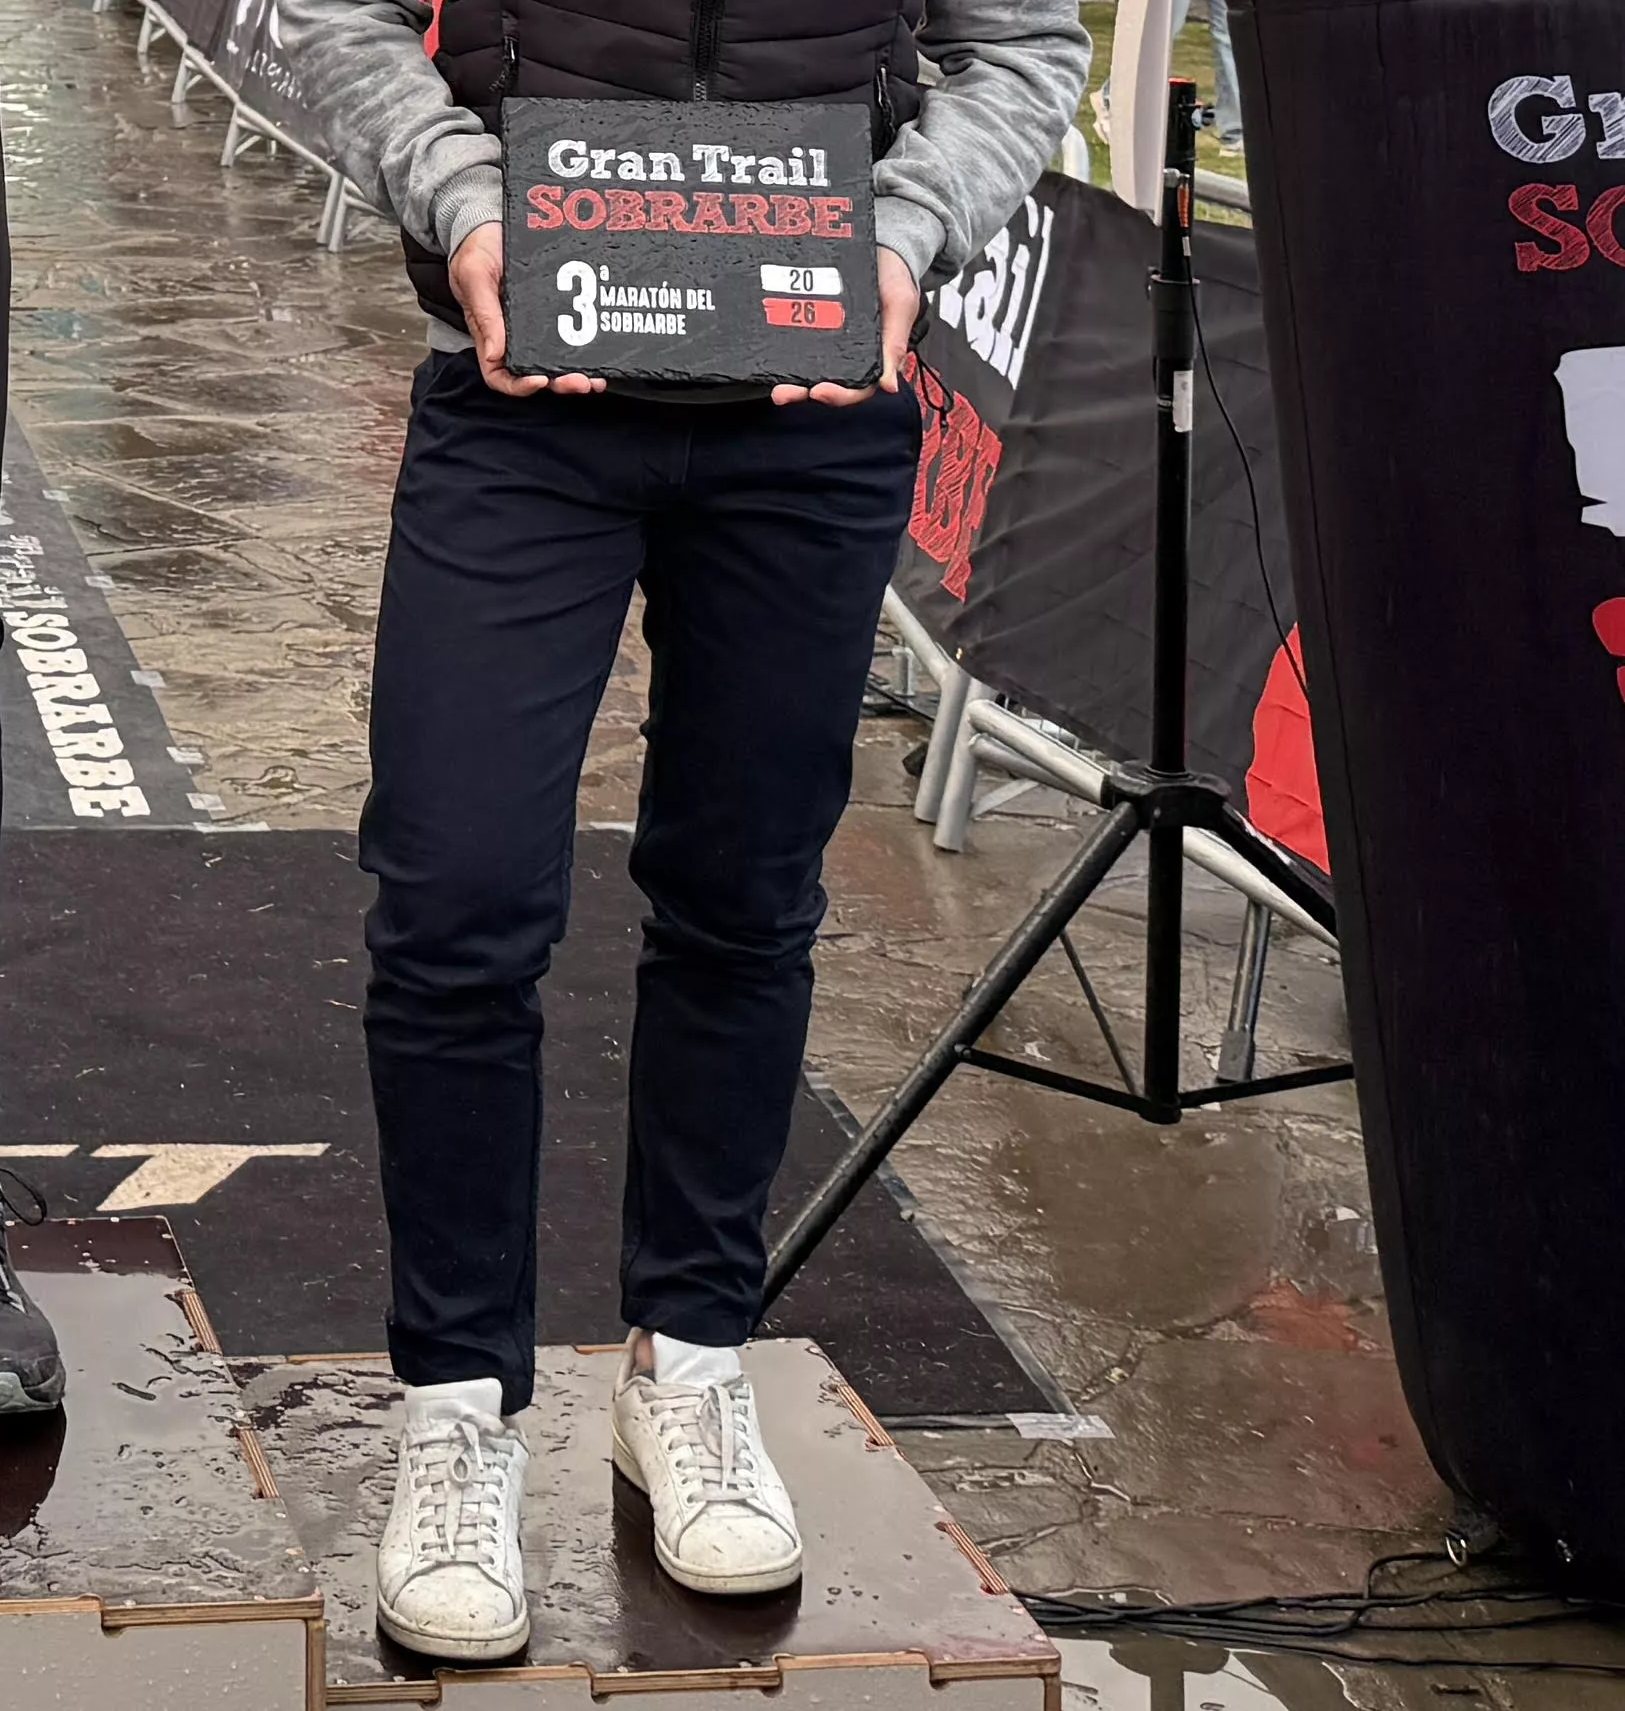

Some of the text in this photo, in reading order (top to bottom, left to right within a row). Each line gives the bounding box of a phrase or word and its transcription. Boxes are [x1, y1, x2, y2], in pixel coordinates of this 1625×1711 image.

[547, 138, 829, 188] Gran Trail
[525, 183, 854, 239] SOBRARBE
[599, 279, 716, 312] MARATÓN DEL
[788, 270, 815, 292] 20
[599, 311, 687, 336] SOBRARBE
[790, 302, 816, 325] 26
[3, 611, 152, 818] SOBRARBE
